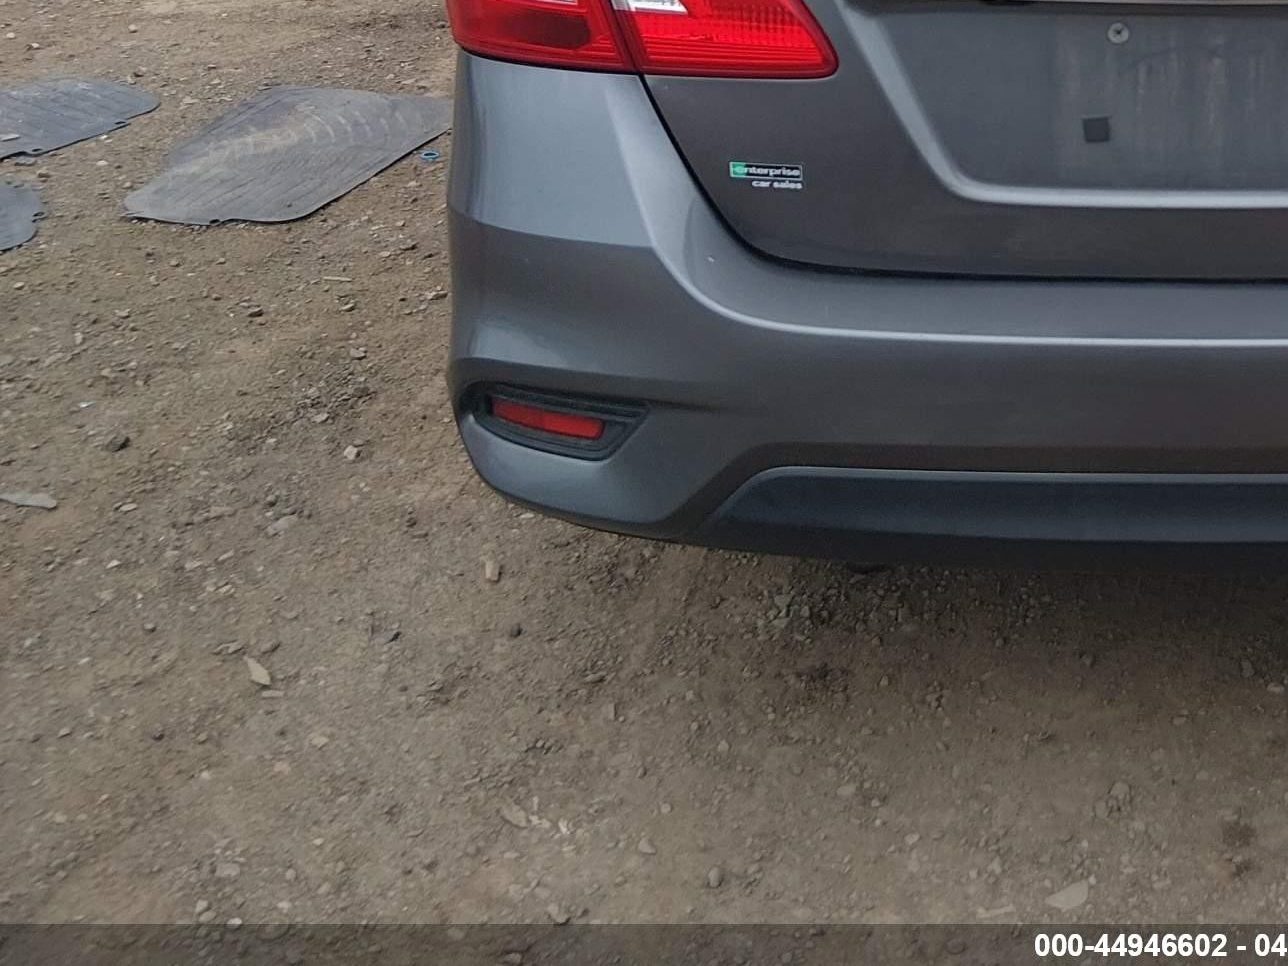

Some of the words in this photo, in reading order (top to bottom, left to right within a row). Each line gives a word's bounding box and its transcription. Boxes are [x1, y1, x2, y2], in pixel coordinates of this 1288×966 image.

[733, 165, 801, 178] enterprise
[752, 180, 771, 188] car
[773, 180, 803, 189] sales
